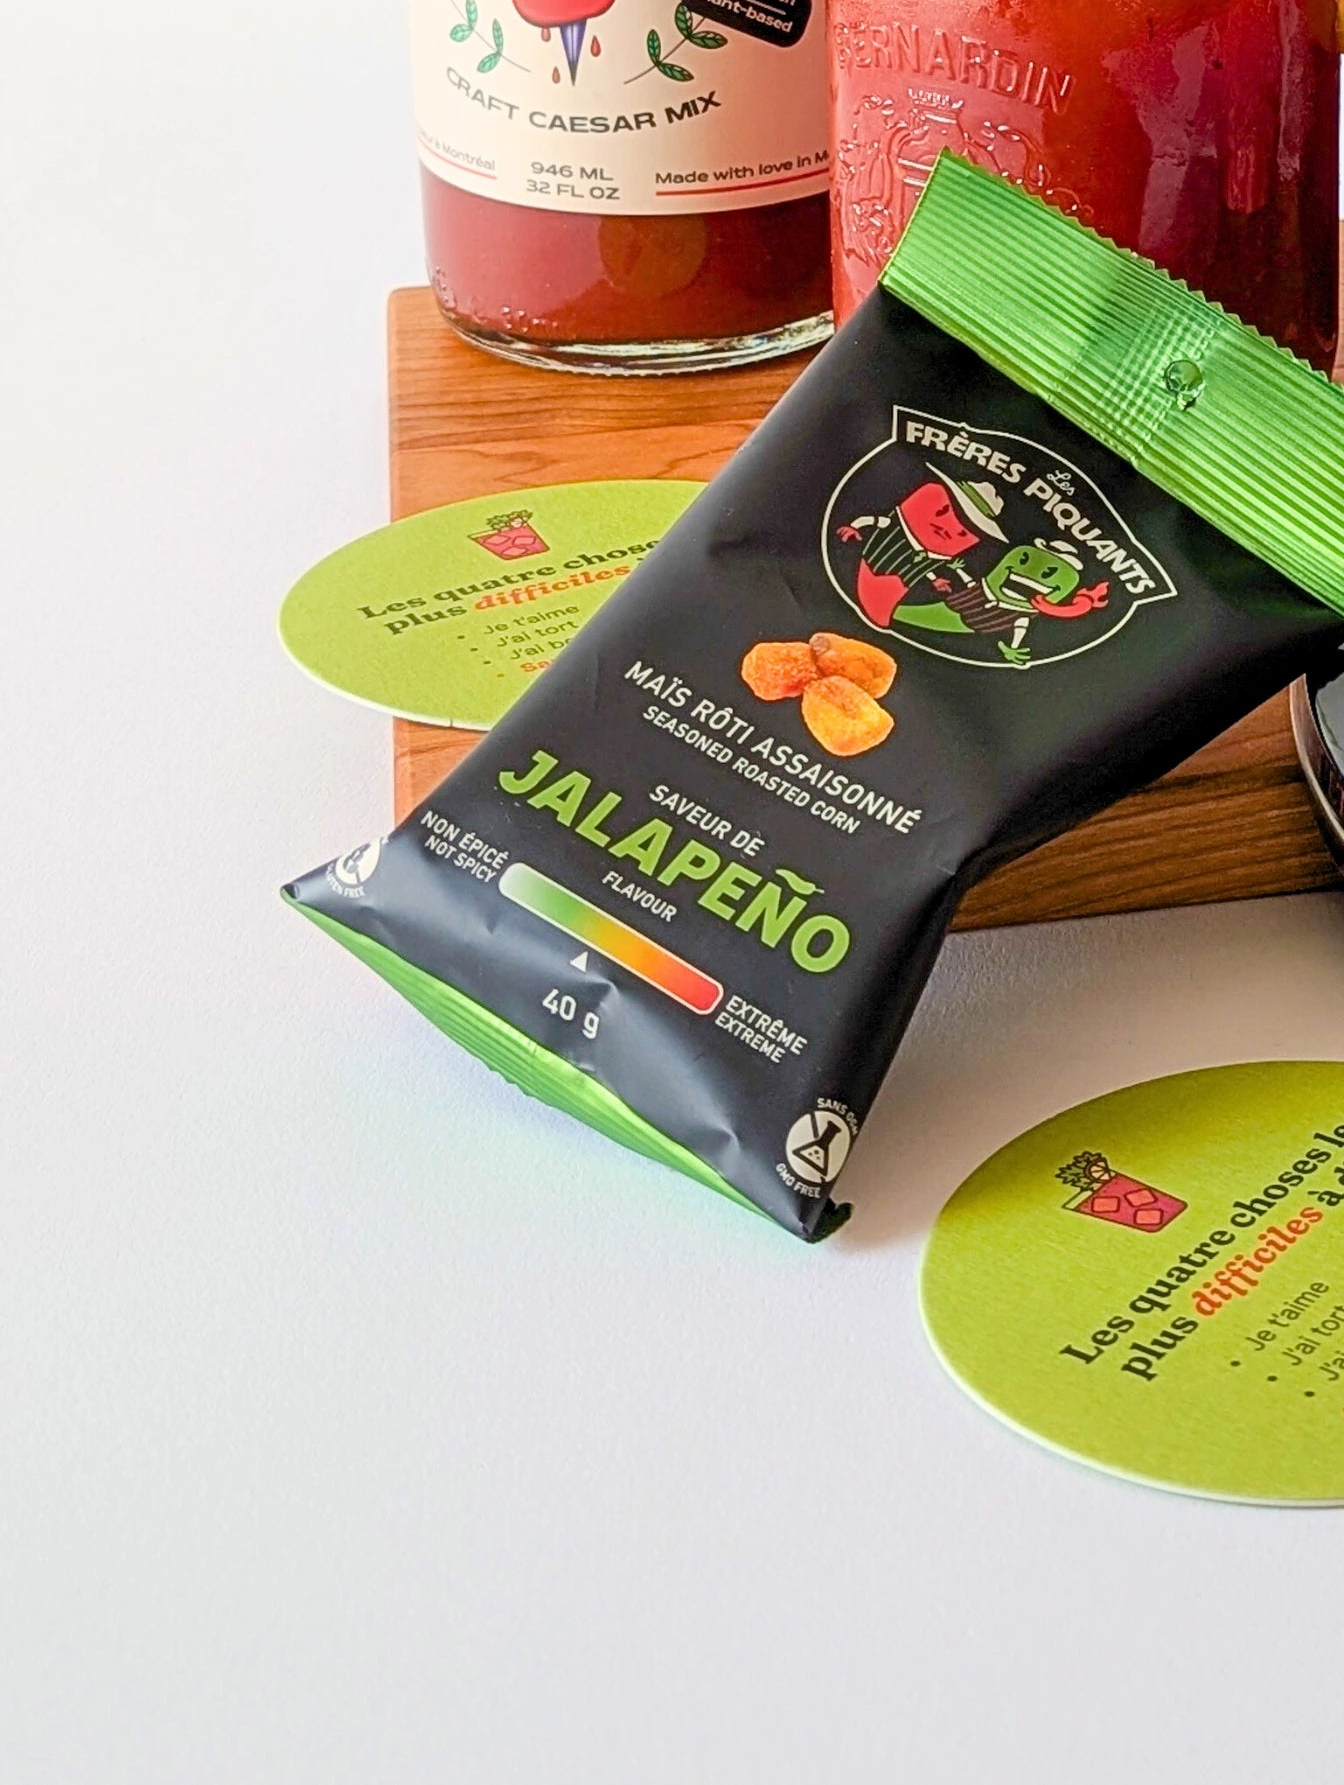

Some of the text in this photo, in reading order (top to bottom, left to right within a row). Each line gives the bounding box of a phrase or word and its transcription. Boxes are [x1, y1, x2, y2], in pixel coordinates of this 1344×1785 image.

[446, 67, 722, 133] CRAFT CAESAR MIX
[526, 179, 620, 200] 32 FL OZ
[531, 161, 614, 181] 946 ML
[655, 172, 708, 184] Made
[713, 167, 754, 180] with
[758, 160, 793, 176] love
[797, 155, 811, 168] in
[906, 420, 1156, 595] FRÈRES PIQUANTS
[1047, 469, 1078, 497] Les
[357, 566, 557, 619] Les quatre
[384, 564, 632, 636] plus difficiles
[483, 605, 580, 635] Je t'aime
[497, 633, 532, 647] J'ai
[535, 619, 580, 637] tort
[509, 644, 545, 660] J'ai
[624, 661, 922, 835] MAÏS RÔTI ASSAISONNÉ
[643, 705, 861, 834] SEASONED ROASTED CORN
[649, 784, 732, 840] SAVEUR
[421, 810, 511, 869] NON ÉPICÉ
[424, 835, 498, 883] NOT SPICY
[499, 749, 850, 973] JALAPEÑO
[602, 870, 678, 922] FLAVOUR
[542, 988, 601, 1040] 40 g
[715, 1012, 786, 1063] EXTREME
[725, 995, 808, 1055] EXTRÊME
[817, 1098, 848, 1115] SANS
[776, 1163, 821, 1198] GMO FREE
[1060, 1315, 1135, 1365] Les
[1129, 1229, 1236, 1315] quatre
[1230, 1147, 1331, 1228] choses
[1121, 1314, 1199, 1382] plus
[1191, 1206, 1324, 1316] difficiles
[1245, 1279, 1330, 1352] Je t'aime
[1282, 1335, 1316, 1366] J'ai
